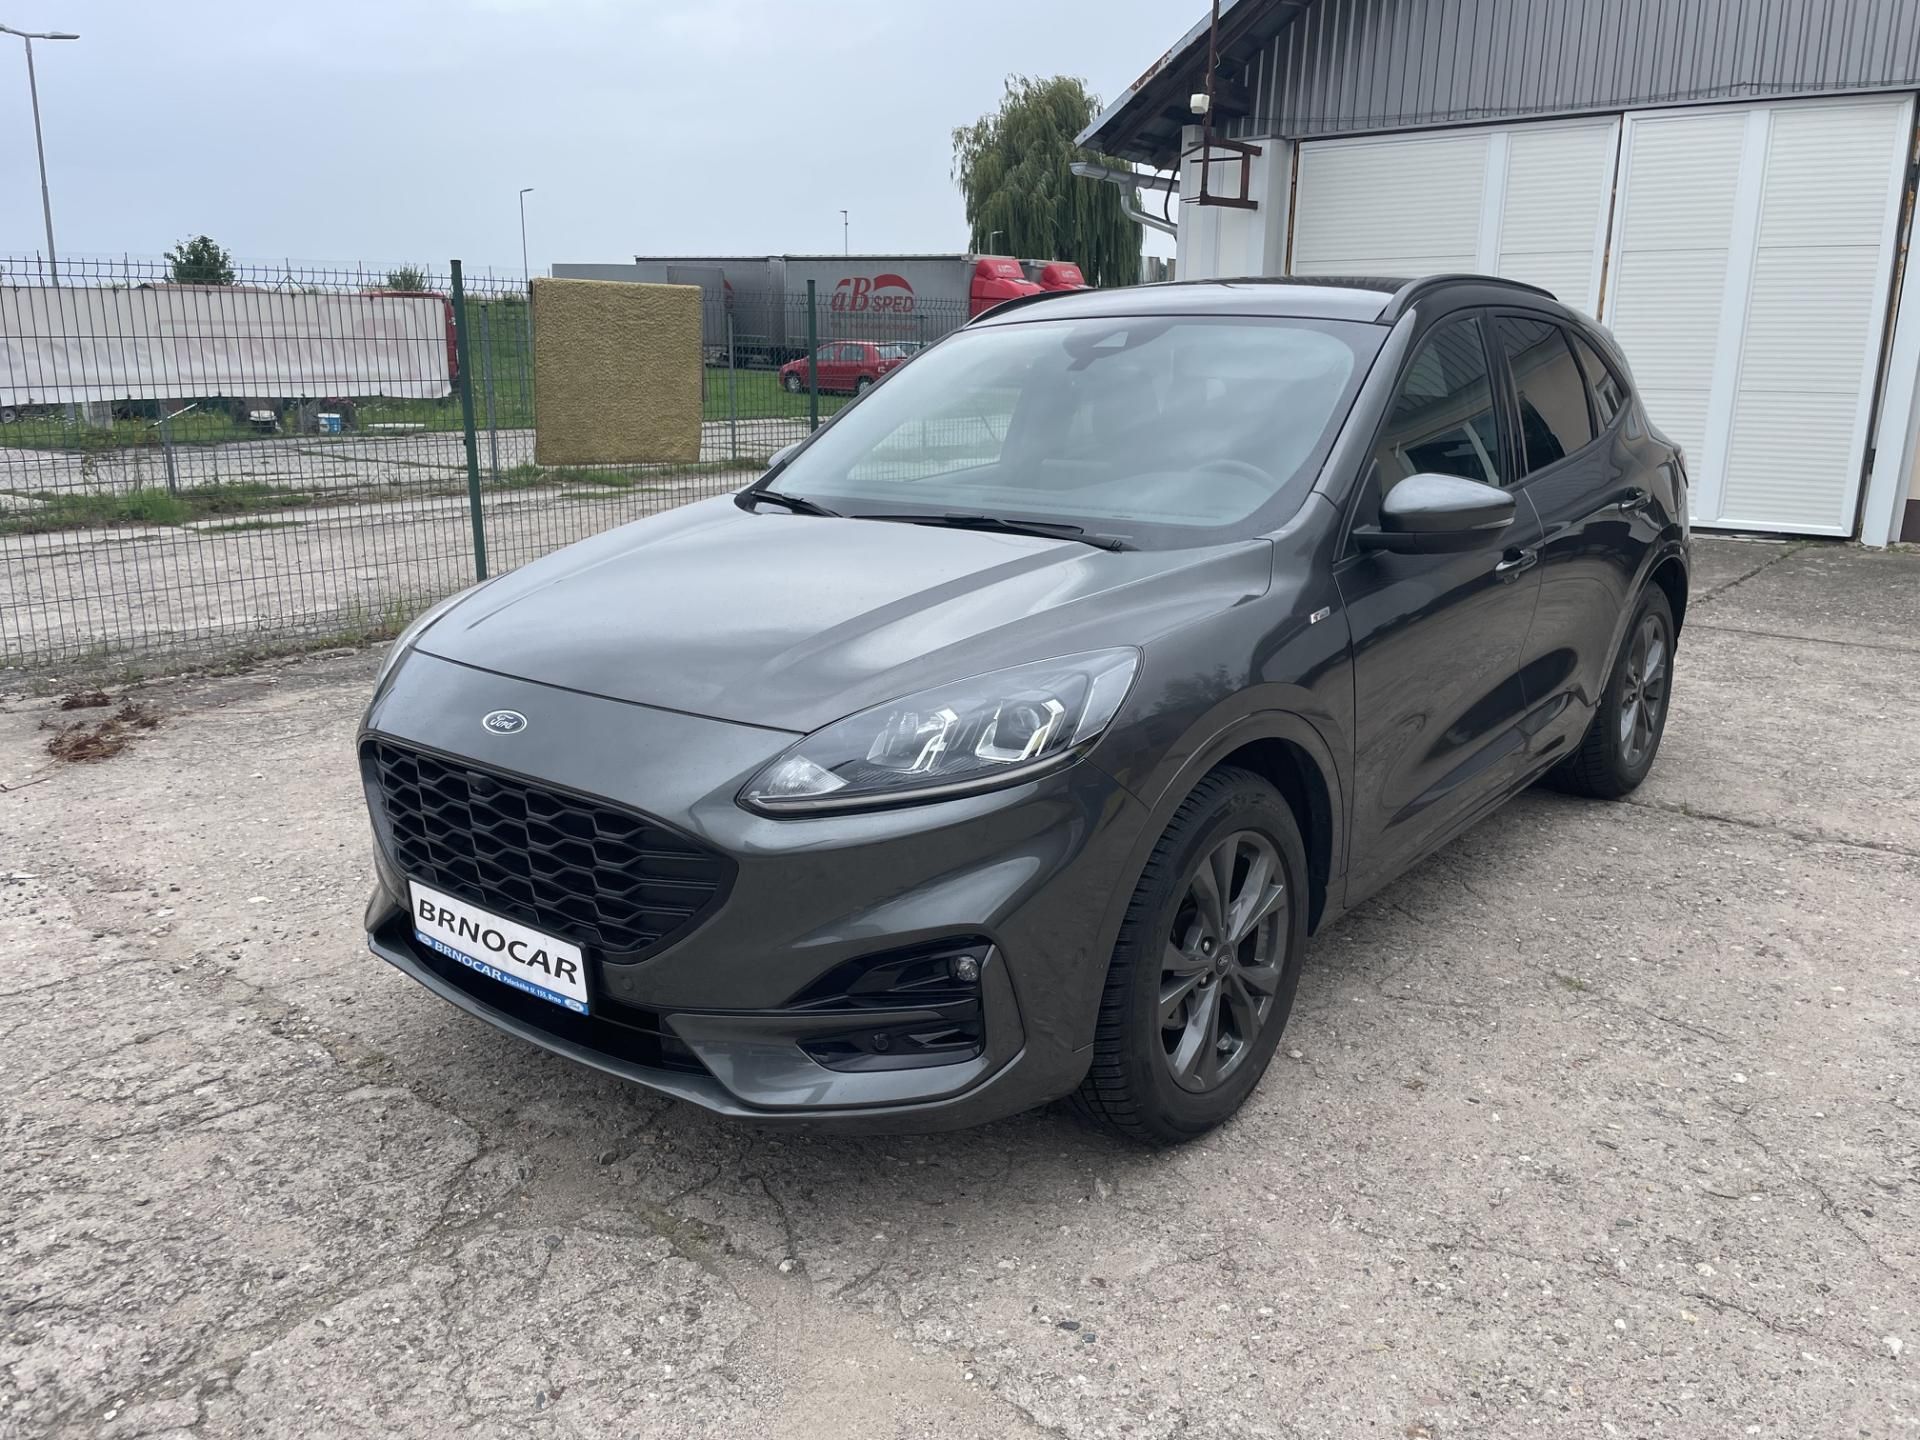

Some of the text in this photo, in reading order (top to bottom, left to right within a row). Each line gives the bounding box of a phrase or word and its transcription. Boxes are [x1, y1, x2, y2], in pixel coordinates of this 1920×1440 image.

[872, 295, 914, 313] SPED
[419, 898, 577, 985] BRNOCAR
[434, 941, 502, 981] BRNOCAR
[548, 994, 562, 1004] Brno
